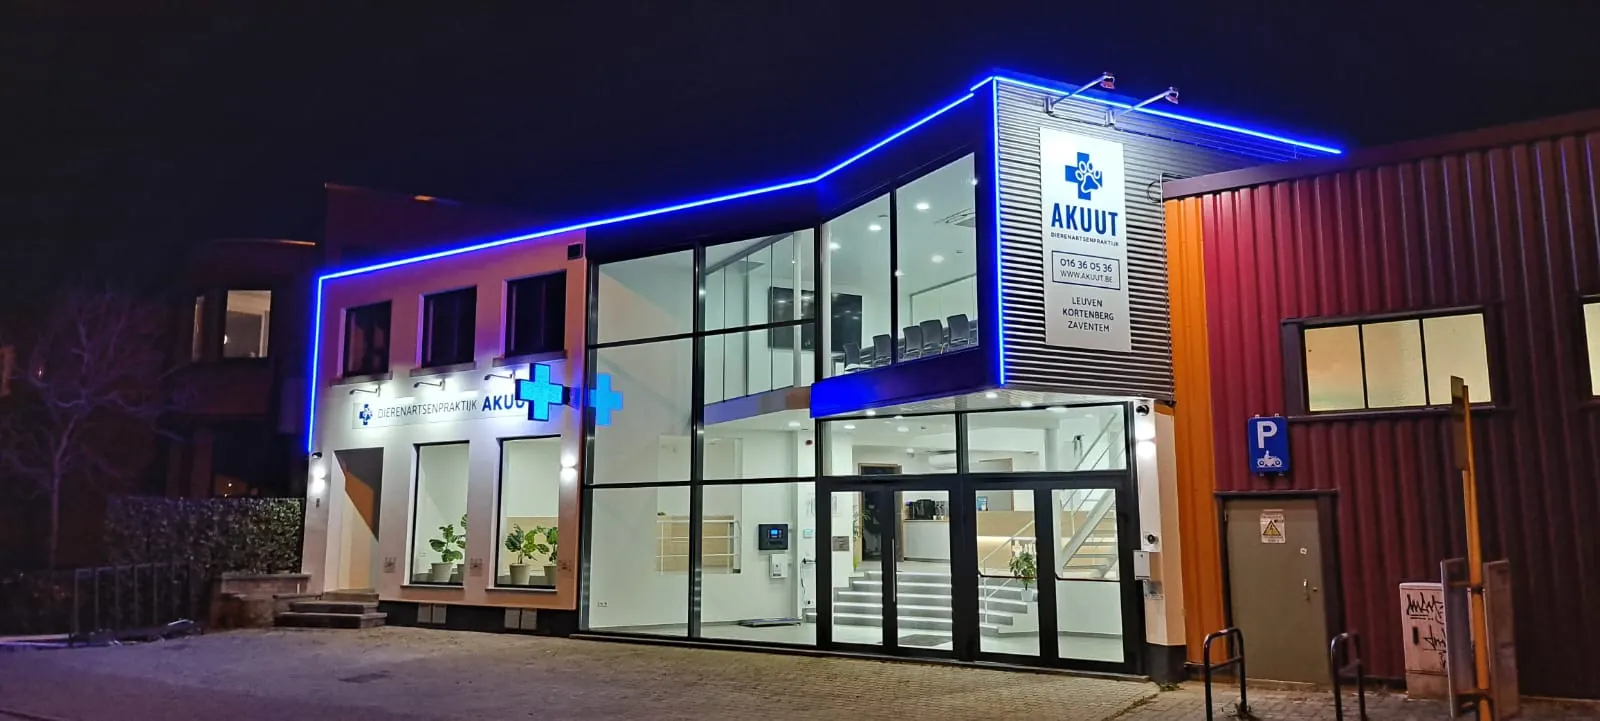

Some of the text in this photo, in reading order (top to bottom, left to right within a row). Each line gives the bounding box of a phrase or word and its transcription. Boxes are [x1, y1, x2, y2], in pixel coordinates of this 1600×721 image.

[1051, 203, 1118, 236] AKUUT
[1051, 232, 1119, 246] DIERENARTSENPRAKTIJK
[1060, 258, 1113, 273] 016 36 05 36
[1060, 270, 1113, 283] WWW.AKUUT.BE
[1072, 297, 1103, 307] LEUVEN
[1062, 308, 1114, 320] KORTENBERG
[1067, 320, 1110, 333] ZAVENTEM
[377, 394, 525, 419] DIERENARTSENPRAKTIJK AKUU
[1257, 420, 1278, 449] P
